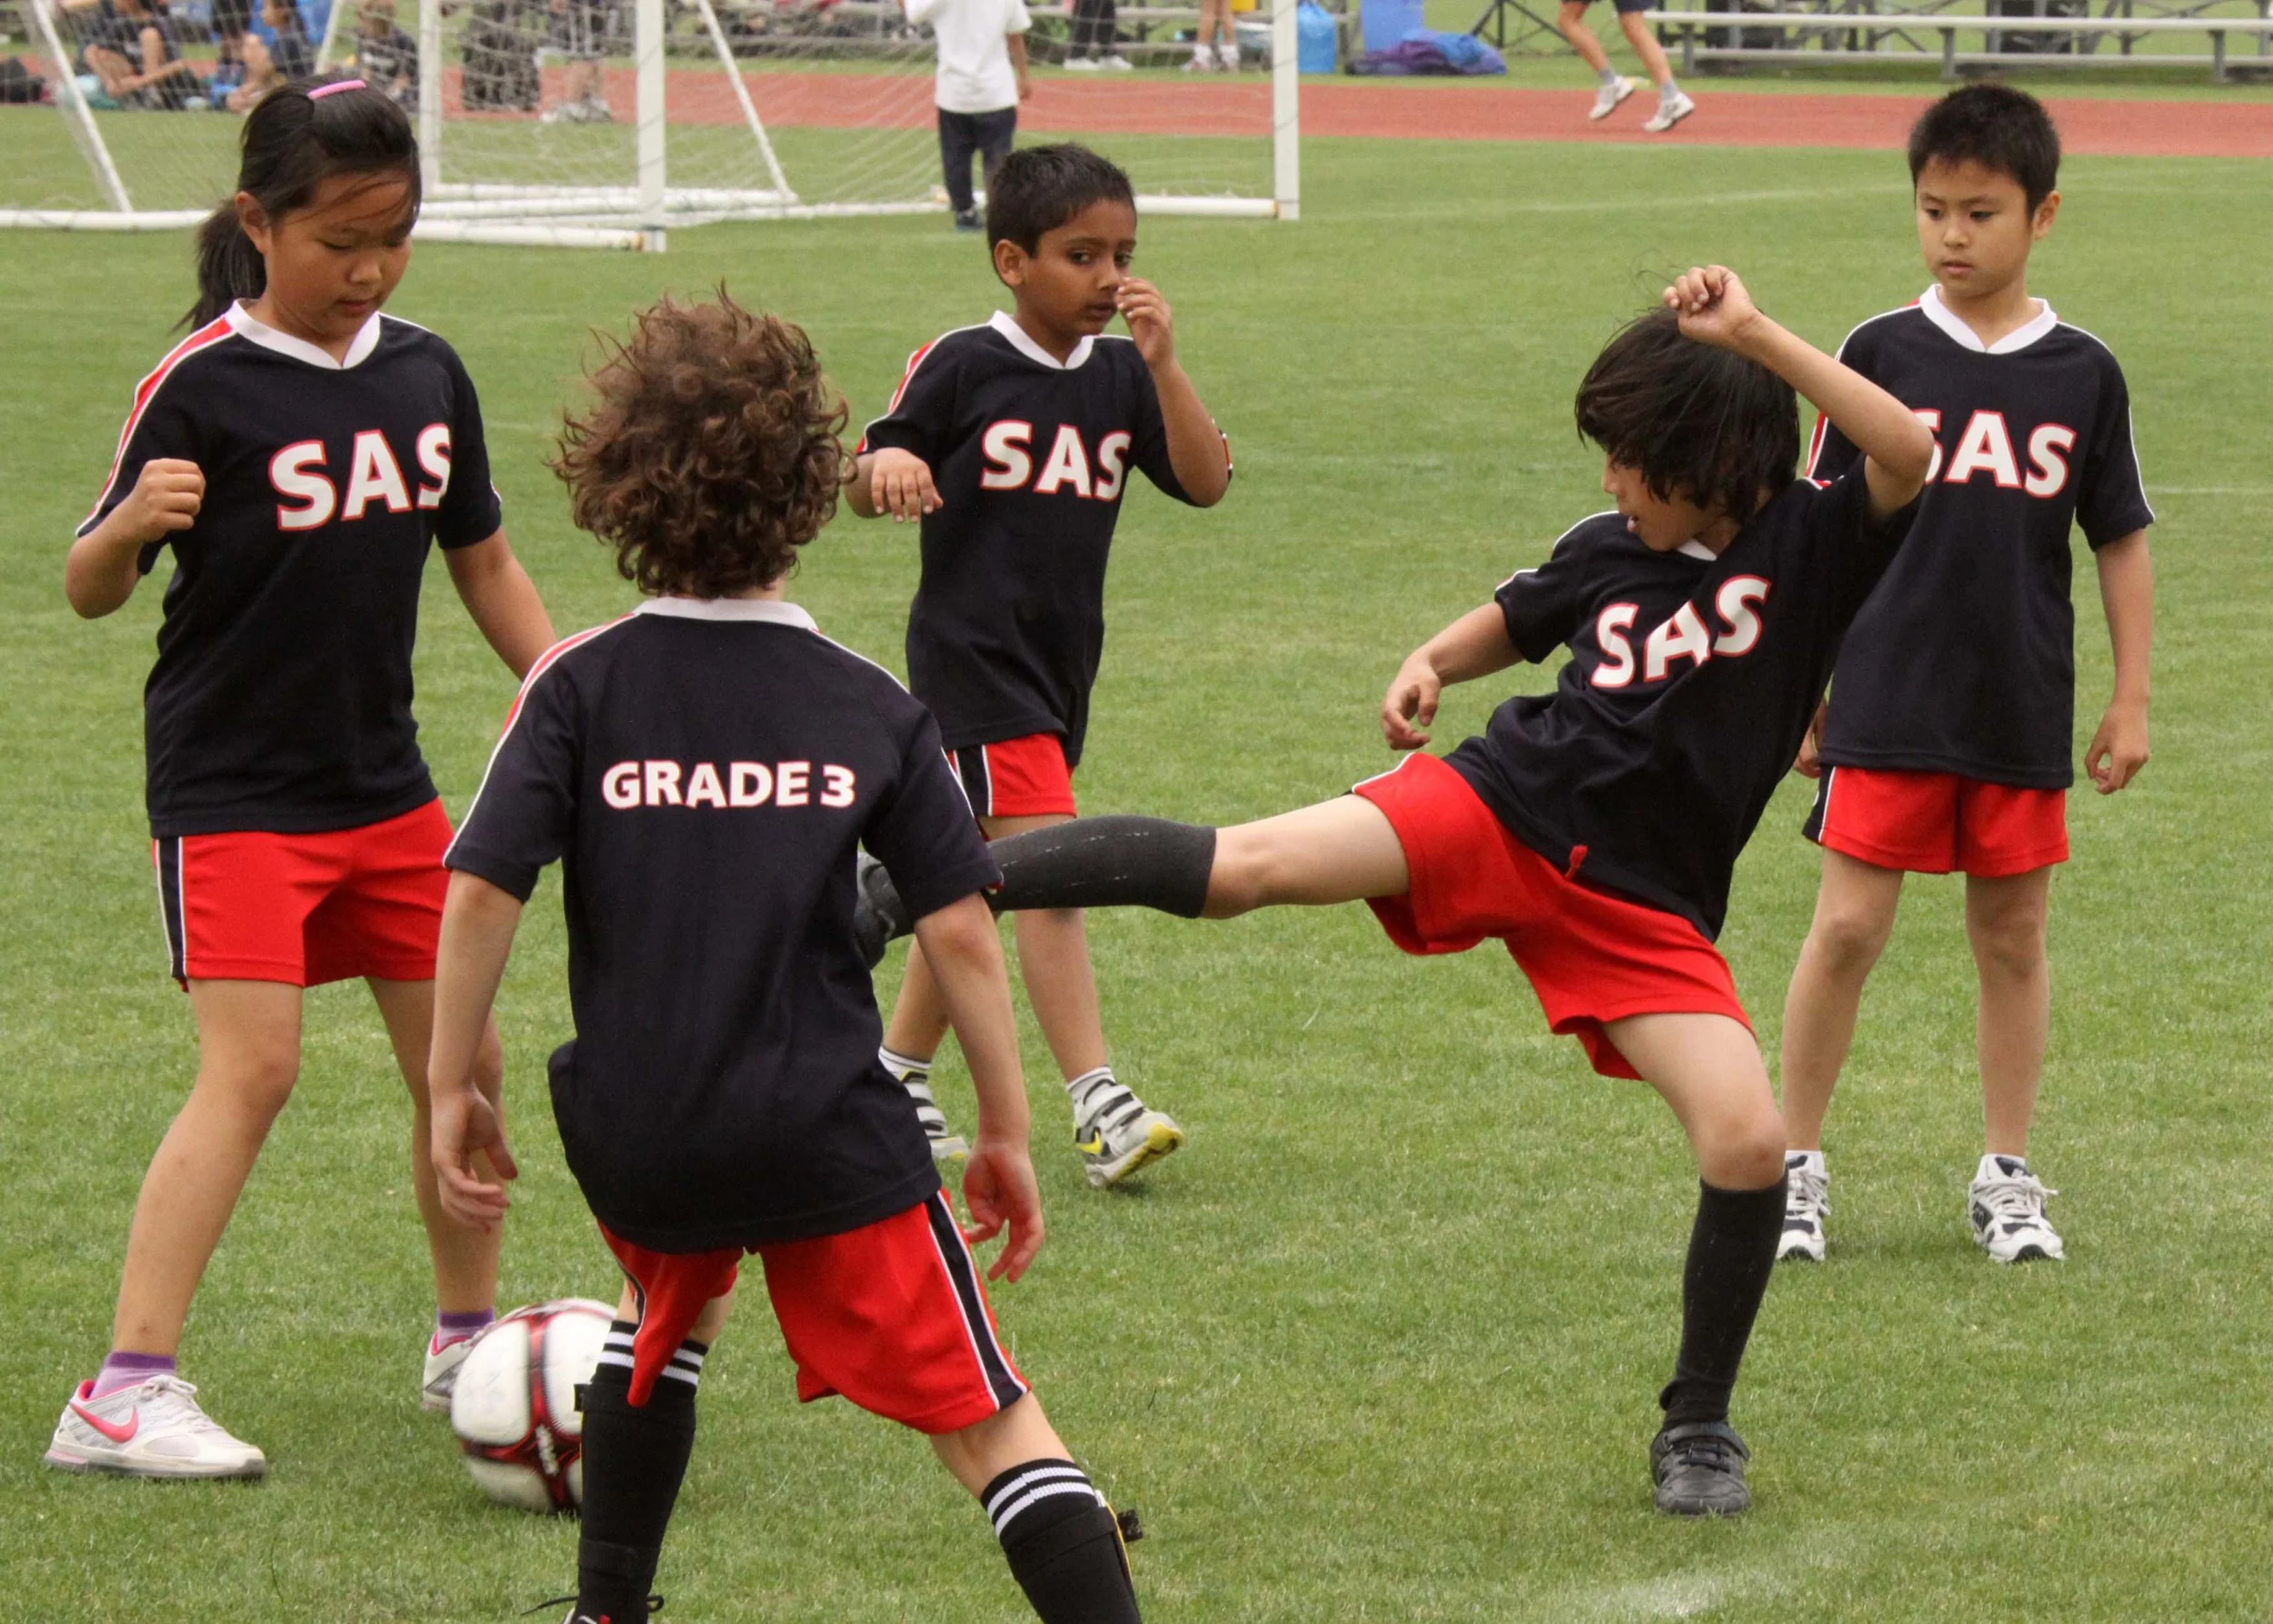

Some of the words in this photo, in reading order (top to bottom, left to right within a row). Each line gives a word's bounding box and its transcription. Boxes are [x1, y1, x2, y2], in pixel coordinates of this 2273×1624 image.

[268, 422, 452, 532] SAS
[979, 418, 1132, 503] SAS
[1590, 574, 1772, 688] SAS
[601, 759, 811, 810] GRADE
[819, 763, 856, 808] 3
